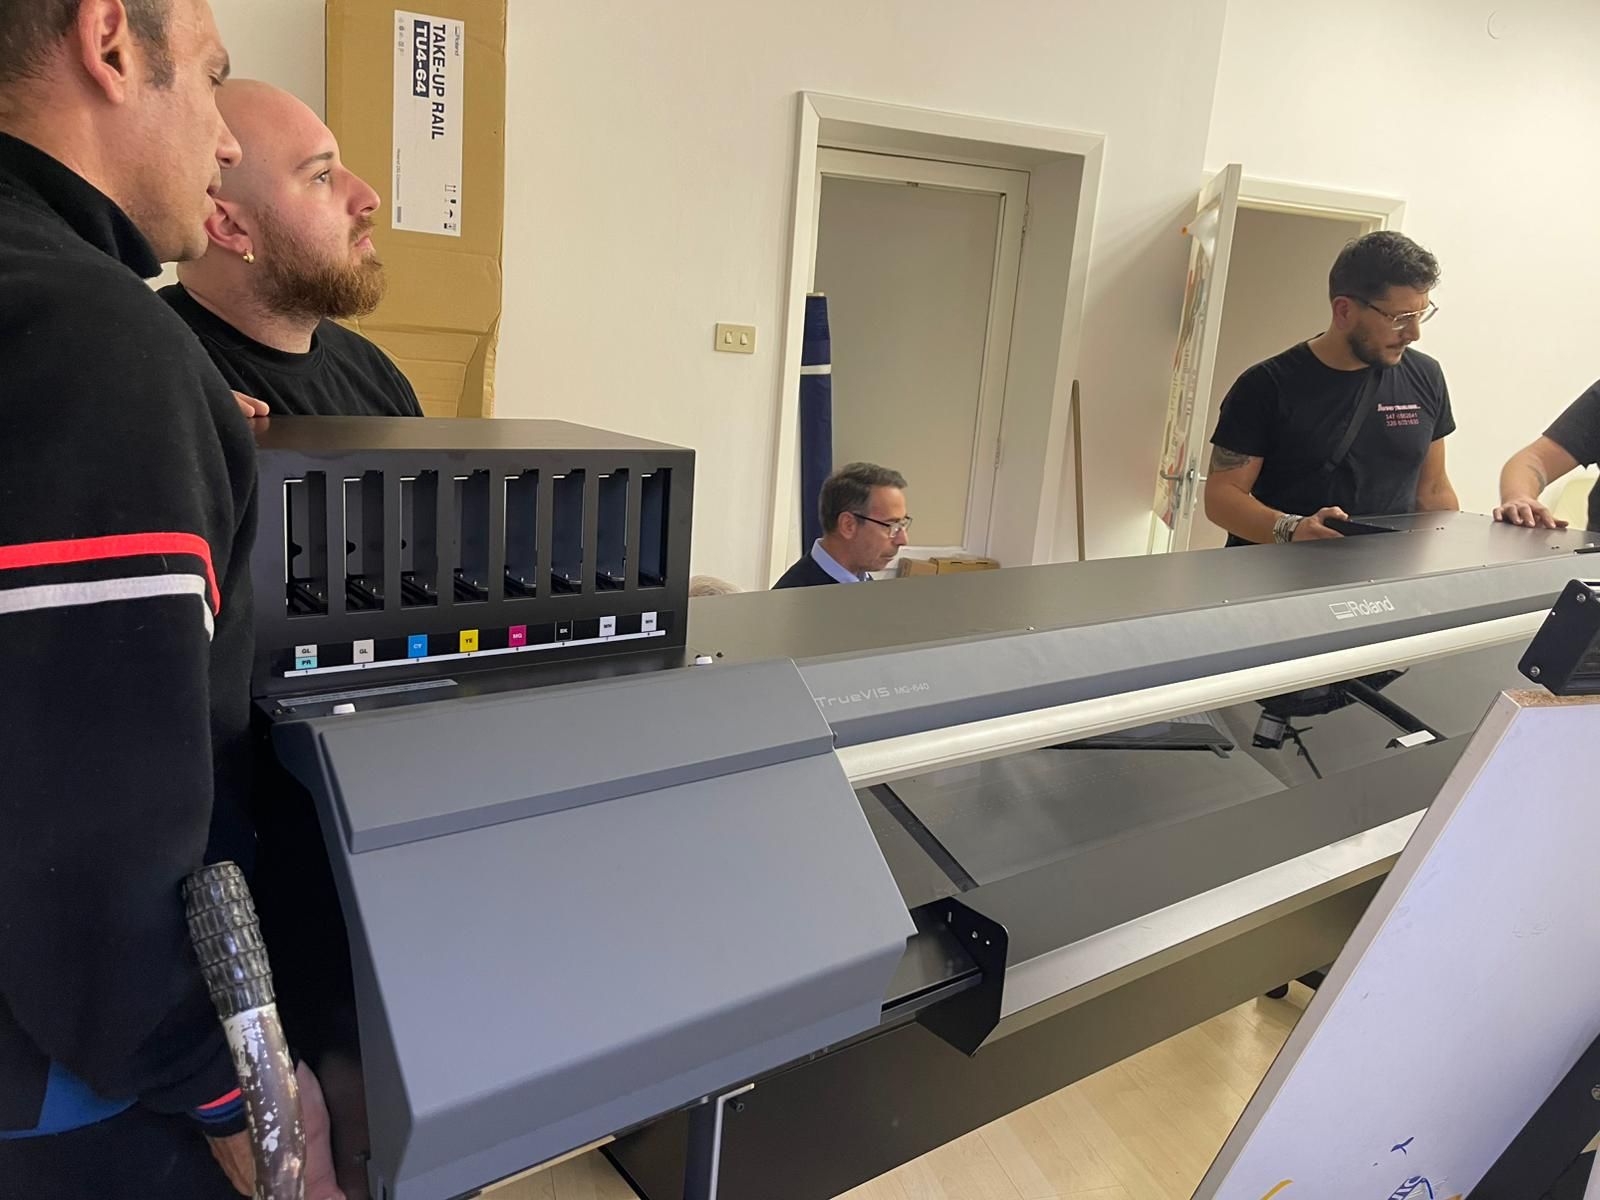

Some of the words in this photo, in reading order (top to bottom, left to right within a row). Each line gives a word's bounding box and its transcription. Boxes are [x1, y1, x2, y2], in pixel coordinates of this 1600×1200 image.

[415, 25, 428, 94] TU4-64
[432, 24, 446, 98] TAKE-UP
[431, 101, 445, 140] RAIL
[1346, 595, 1395, 617] Roland
[814, 686, 890, 708] TrueVIS
